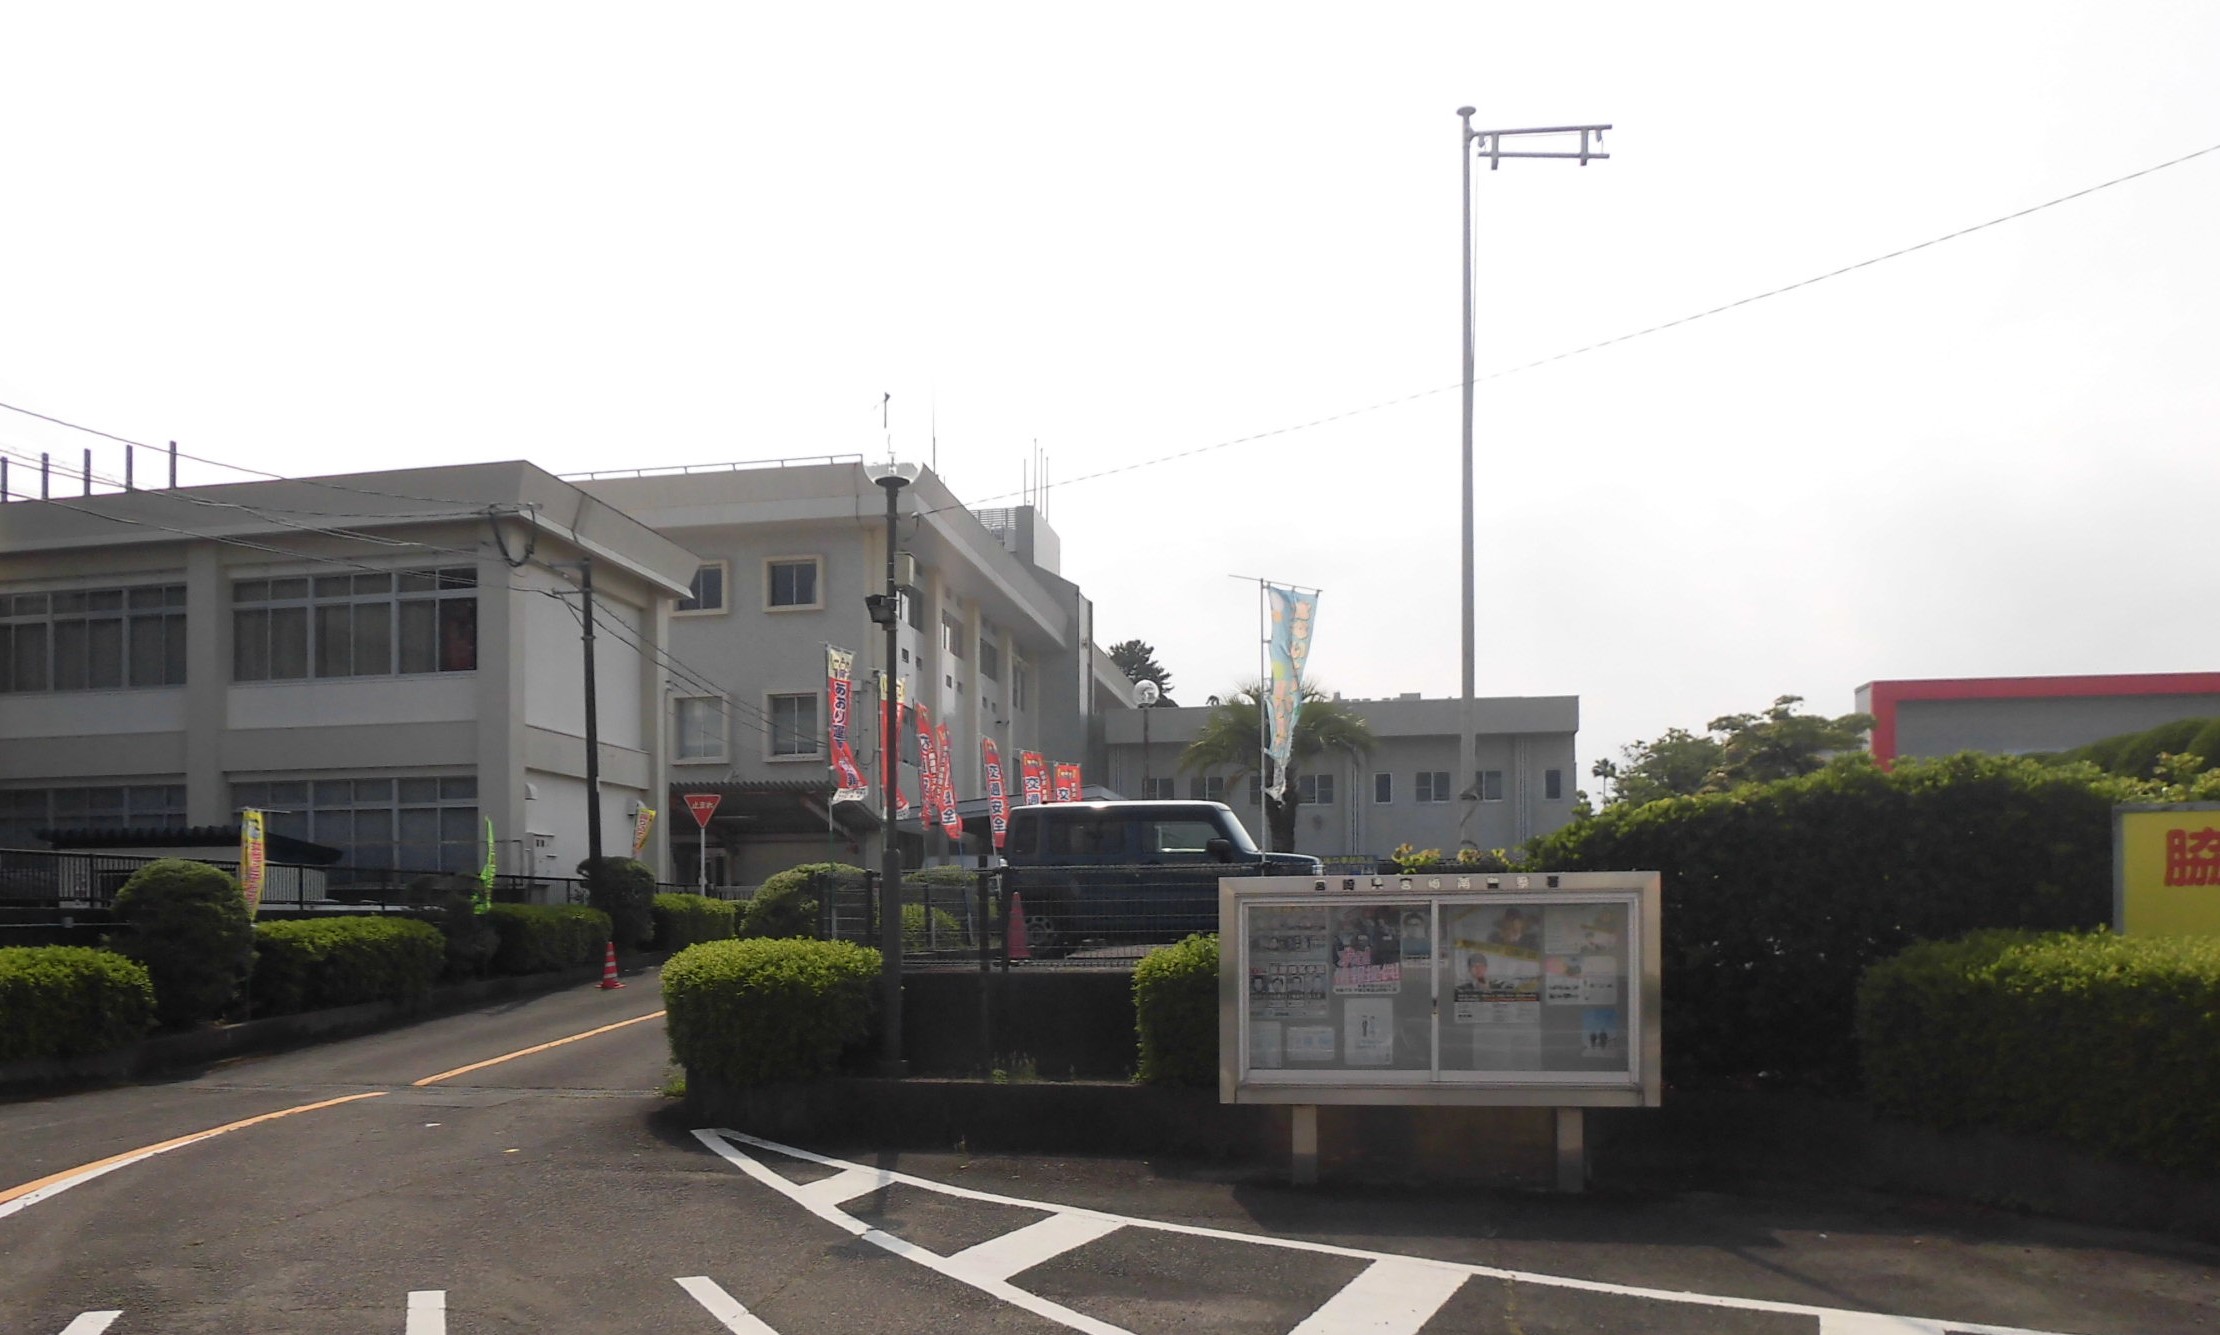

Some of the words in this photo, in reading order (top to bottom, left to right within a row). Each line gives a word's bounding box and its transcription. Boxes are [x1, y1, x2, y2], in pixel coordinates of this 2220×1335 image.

[985, 763, 1007, 833] 交通安全
[1057, 787, 1072, 802] 交
[692, 800, 716, 810] 止まれ
